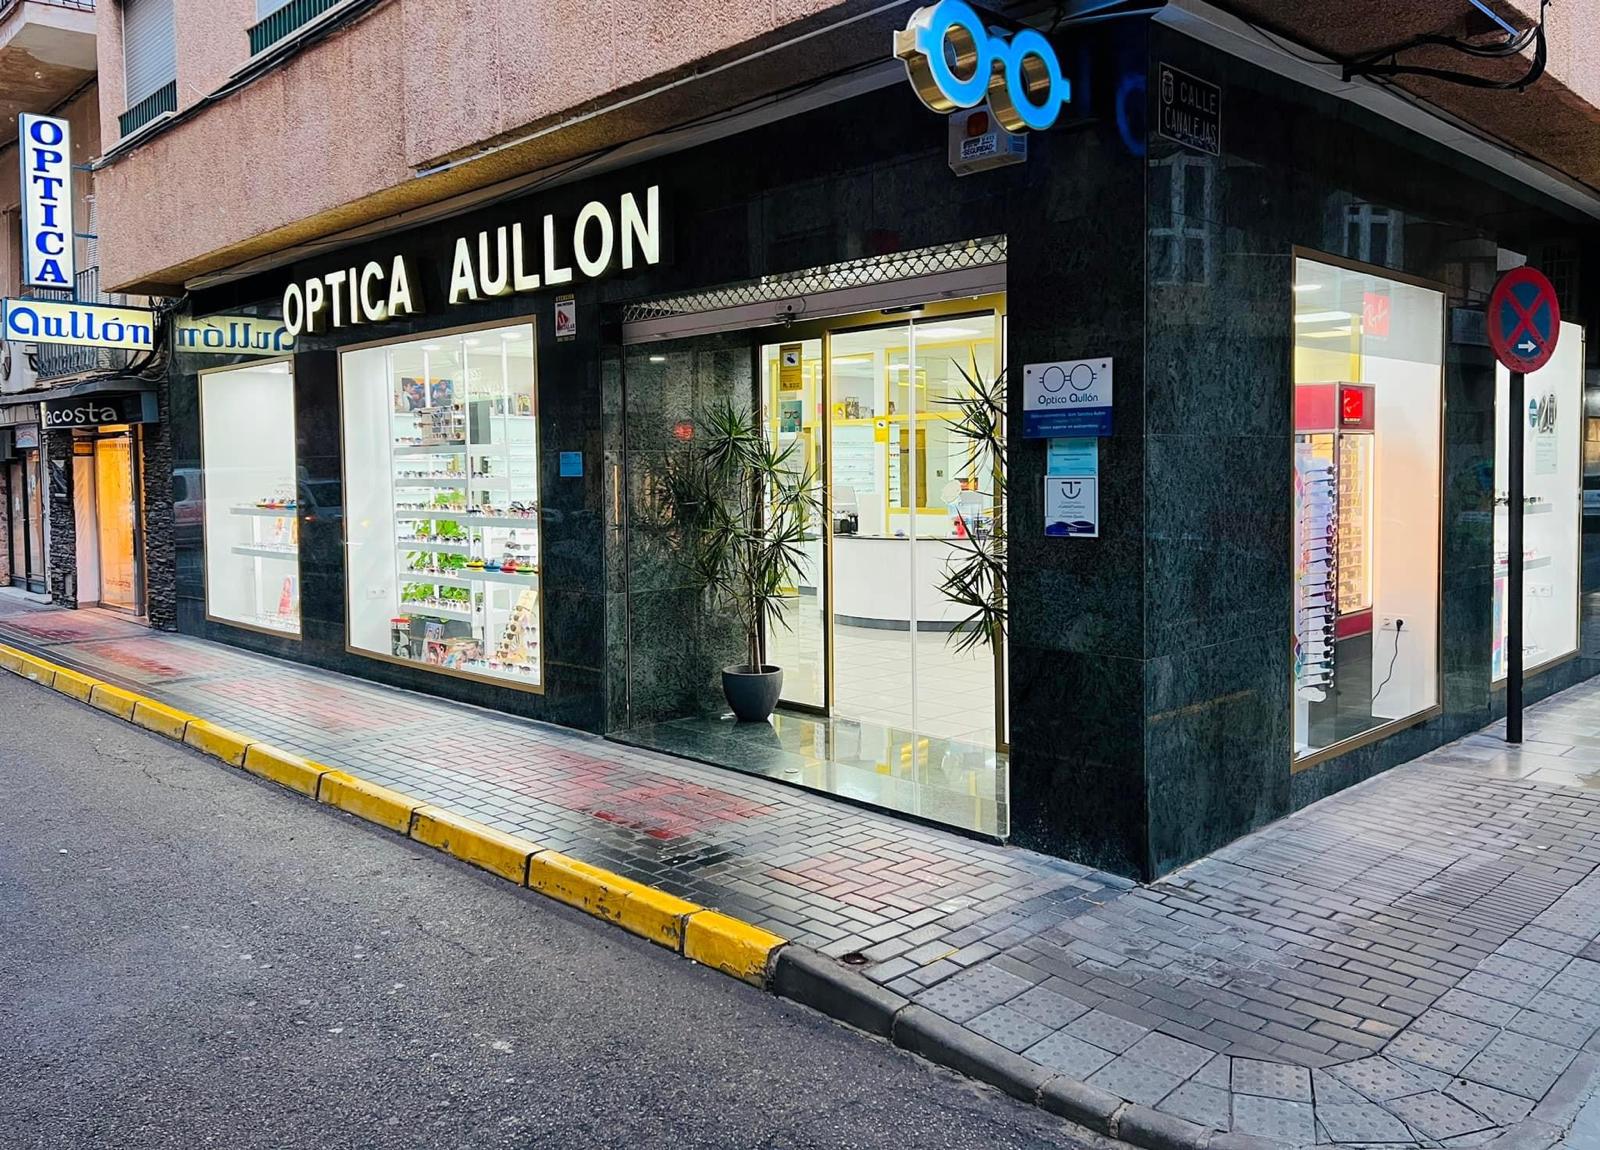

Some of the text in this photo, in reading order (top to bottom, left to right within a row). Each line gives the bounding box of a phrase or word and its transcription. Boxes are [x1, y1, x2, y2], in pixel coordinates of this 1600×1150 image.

[1180, 81, 1217, 116] CALLE
[1164, 106, 1217, 147] CANALEJAS
[30, 120, 69, 284] OPTICA
[282, 184, 660, 337] OPTICA AULLON
[46, 402, 118, 424] acosta
